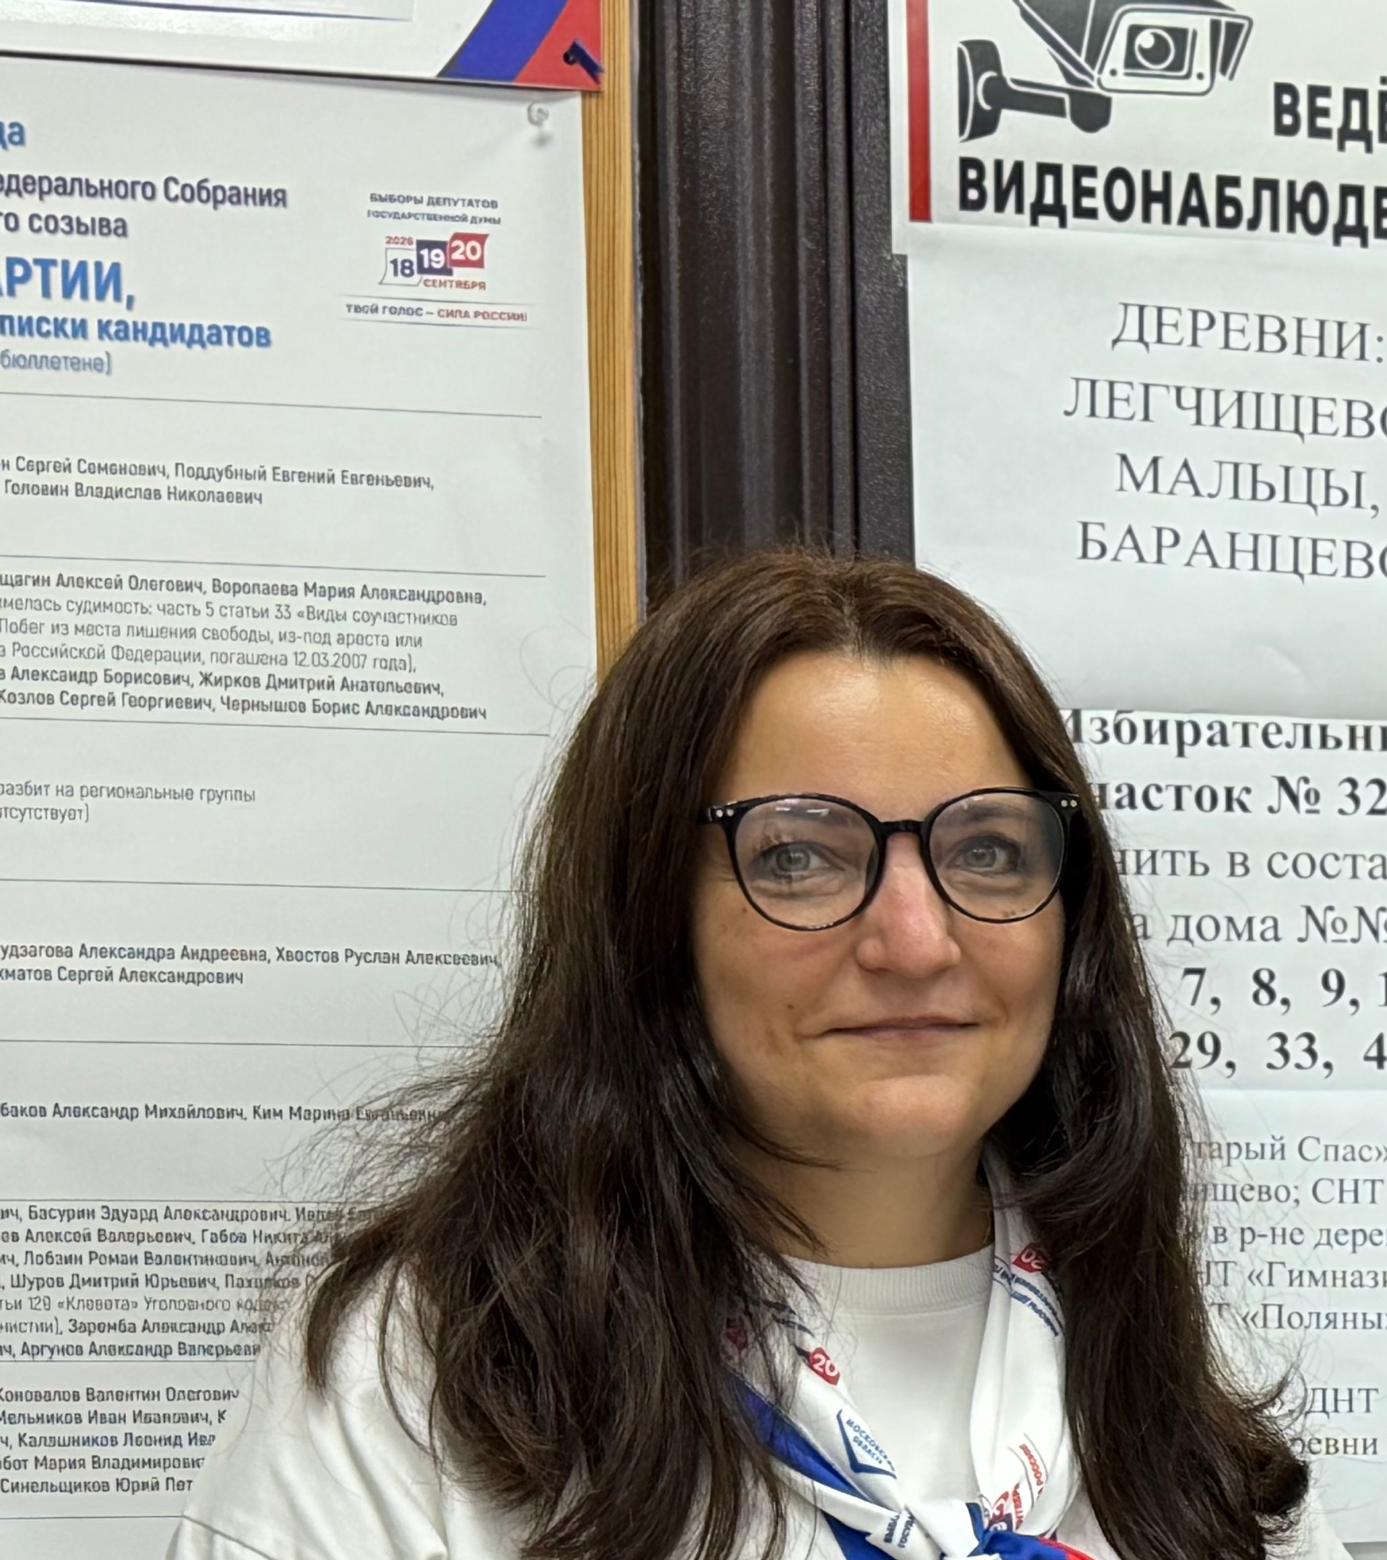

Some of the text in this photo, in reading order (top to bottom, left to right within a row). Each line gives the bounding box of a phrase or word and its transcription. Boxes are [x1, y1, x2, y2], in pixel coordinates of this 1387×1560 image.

[163, 176, 288, 209] Собрания
[370, 193, 498, 209] ВЫБОРЫ ДЕПУТАТОВ
[28, 212, 128, 237] созыва
[390, 240, 481, 278] 18 19 20
[423, 278, 486, 290] СЕНТЯБРЯ
[346, 303, 470, 319] ТВОЙ ГОЛОС СИЛА
[97, 318, 272, 350] кандидатов
[1111, 302, 1386, 364] ДЕРЕВНИ:
[16, 456, 72, 476] Сергей
[77, 459, 170, 480] Семенович,
[175, 463, 267, 483] Поддубный
[272, 466, 336, 486] Евгений
[341, 469, 434, 490] Евгеньевич,
[1113, 452, 1381, 518] МАЛЬЦЫ,
[5, 479, 263, 505] Головин Владислав Николаевич
[56, 573, 487, 607] Алексей Олегович, Воропаева Мария Александровна,
[66, 599, 458, 627] судимость: часть 5 статьи 33 «Виды соучастников
[51, 621, 423, 649] из места лишения свободы, из-под ареста или
[12, 641, 368, 671] Российской Федерации, погашена 12.03.2007
[11, 665, 98, 685] Александр
[103, 668, 195, 690] Борисович,
[199, 671, 262, 690] Жирков
[265, 673, 336, 695] Дмитрий
[340, 676, 445, 699] Анатольевич,
[60, 689, 487, 721] Сергей Георгиевич, Чернышов Борис Александрович
[56, 784, 256, 806] на региональные группы
[1267, 776, 1320, 814] №
[1228, 854, 1250, 877] в
[1166, 914, 1282, 945] дома
[78, 943, 401, 967] Александра Андреевна, Хвостов Руслан
[57, 965, 244, 986] Сергей Александрович
[1181, 967, 1221, 1009] 7,
[1251, 968, 1291, 1011] 8,
[1320, 969, 1360, 1013] 9,
[1168, 1031, 1237, 1078] 29,
[1265, 1032, 1333, 1078] 33,
[52, 1102, 284, 1122] Александр Михайлович, Ким
[1311, 1178, 1384, 1206] СНТ
[28, 1204, 96, 1223] Басурин
[100, 1204, 159, 1223] Эдуард
[25, 1226, 92, 1243] Алексей
[97, 1228, 196, 1245] Валерьевич,
[1213, 1226, 1228, 1244] в
[1240, 1225, 1304, 1252] р-не
[88, 1251, 138, 1266] Роман
[10, 1274, 65, 1291] Шуров
[69, 1272, 139, 1291] Дмитрий
[145, 1274, 220, 1291] Юрьевич,
[141, 1318, 225, 1335] Александр
[21, 1341, 84, 1360] Аргунов
[89, 1341, 173, 1361] Александр
[811, 1352, 838, 1377] 20
[86, 1387, 160, 1402] Валентин
[1304, 1387, 1379, 1420] ДНТ
[88, 1410, 126, 1425] Иван
[132, 1410, 213, 1426] Иванович,
[18, 1432, 118, 1448] Калашников
[123, 1432, 183, 1449] Леонид
[34, 1455, 85, 1473] Мария
[0, 1477, 160, 1495] Синельщиков Юрий
